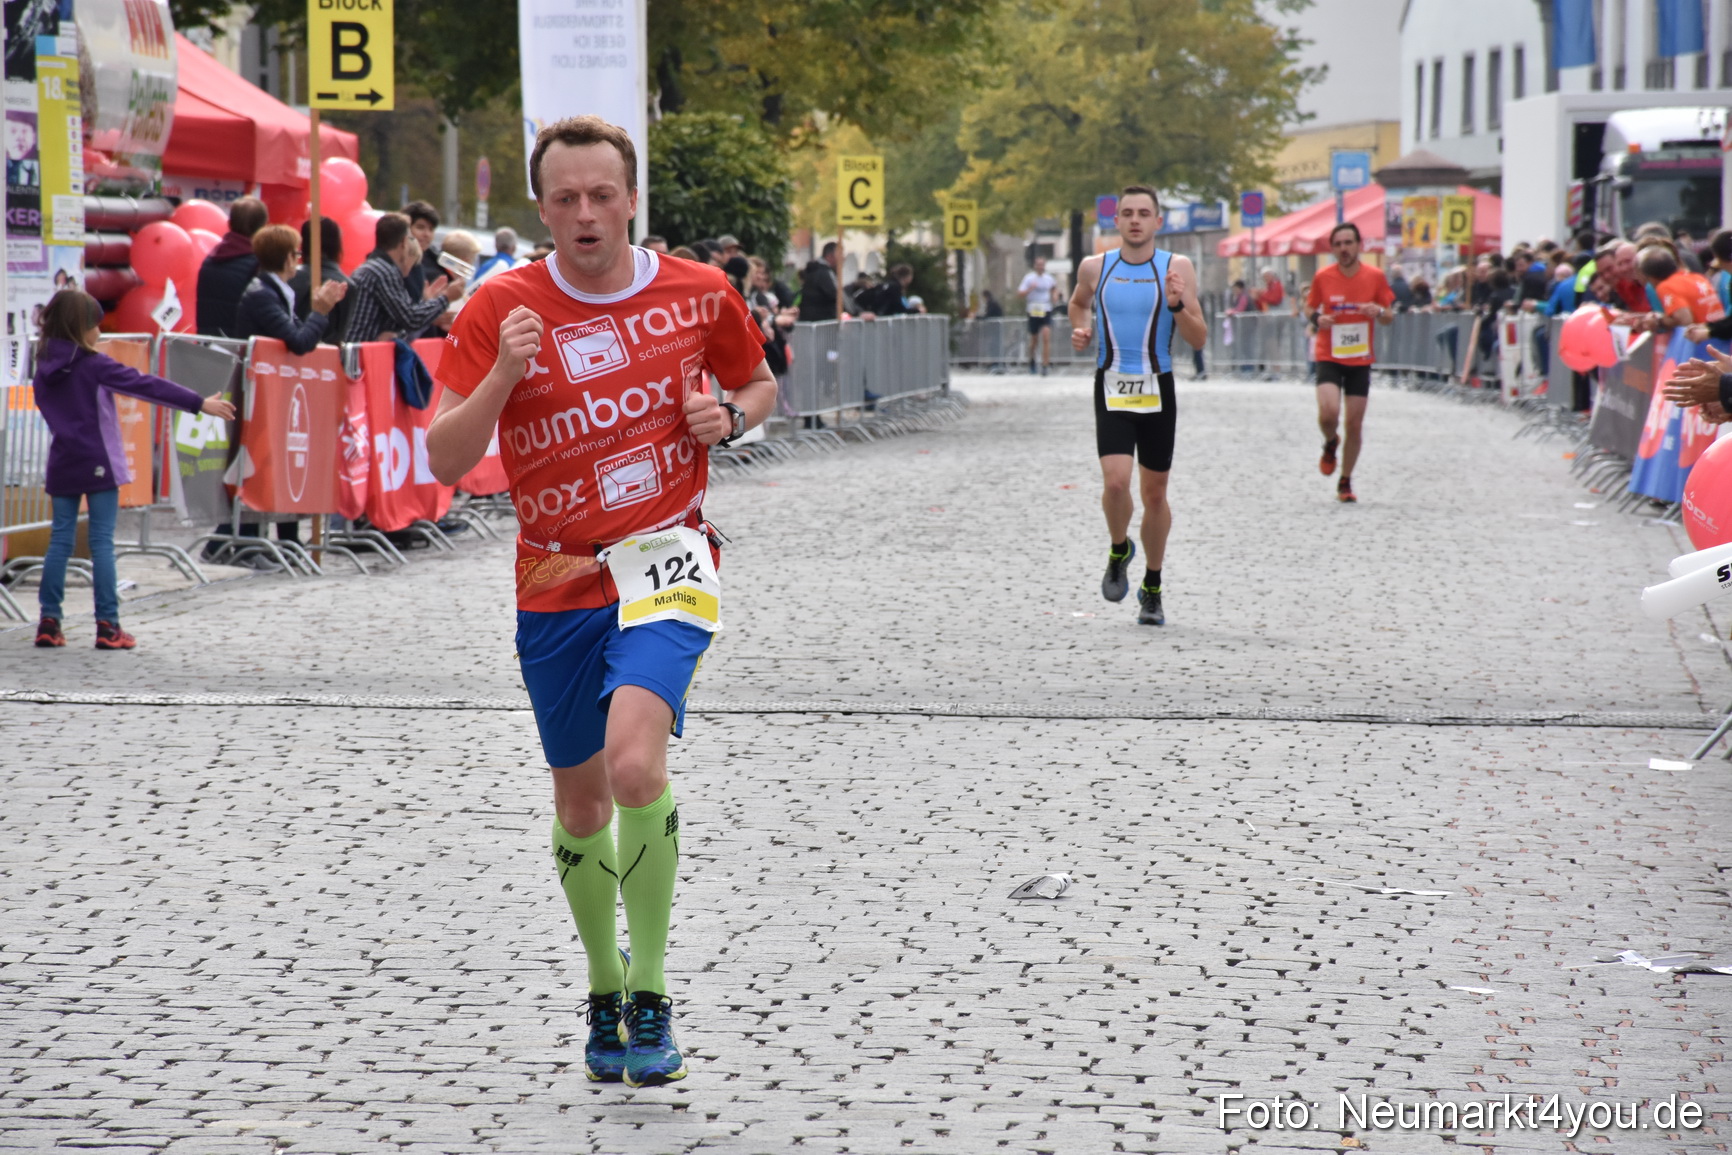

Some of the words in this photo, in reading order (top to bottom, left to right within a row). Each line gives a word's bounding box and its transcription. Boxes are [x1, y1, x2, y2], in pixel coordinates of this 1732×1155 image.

[331, 21, 372, 80] B
[850, 177, 871, 209] C
[952, 215, 970, 238] D
[1450, 209, 1467, 233] D
[557, 320, 611, 342] raumbox
[638, 334, 697, 361] schenken
[1117, 380, 1145, 394] 277
[502, 376, 674, 460] raumbox
[560, 435, 615, 461] wohnen
[625, 412, 676, 438] outdoor
[599, 450, 652, 474] raumbox
[644, 551, 702, 591] 122
[654, 591, 697, 606] Mathias
